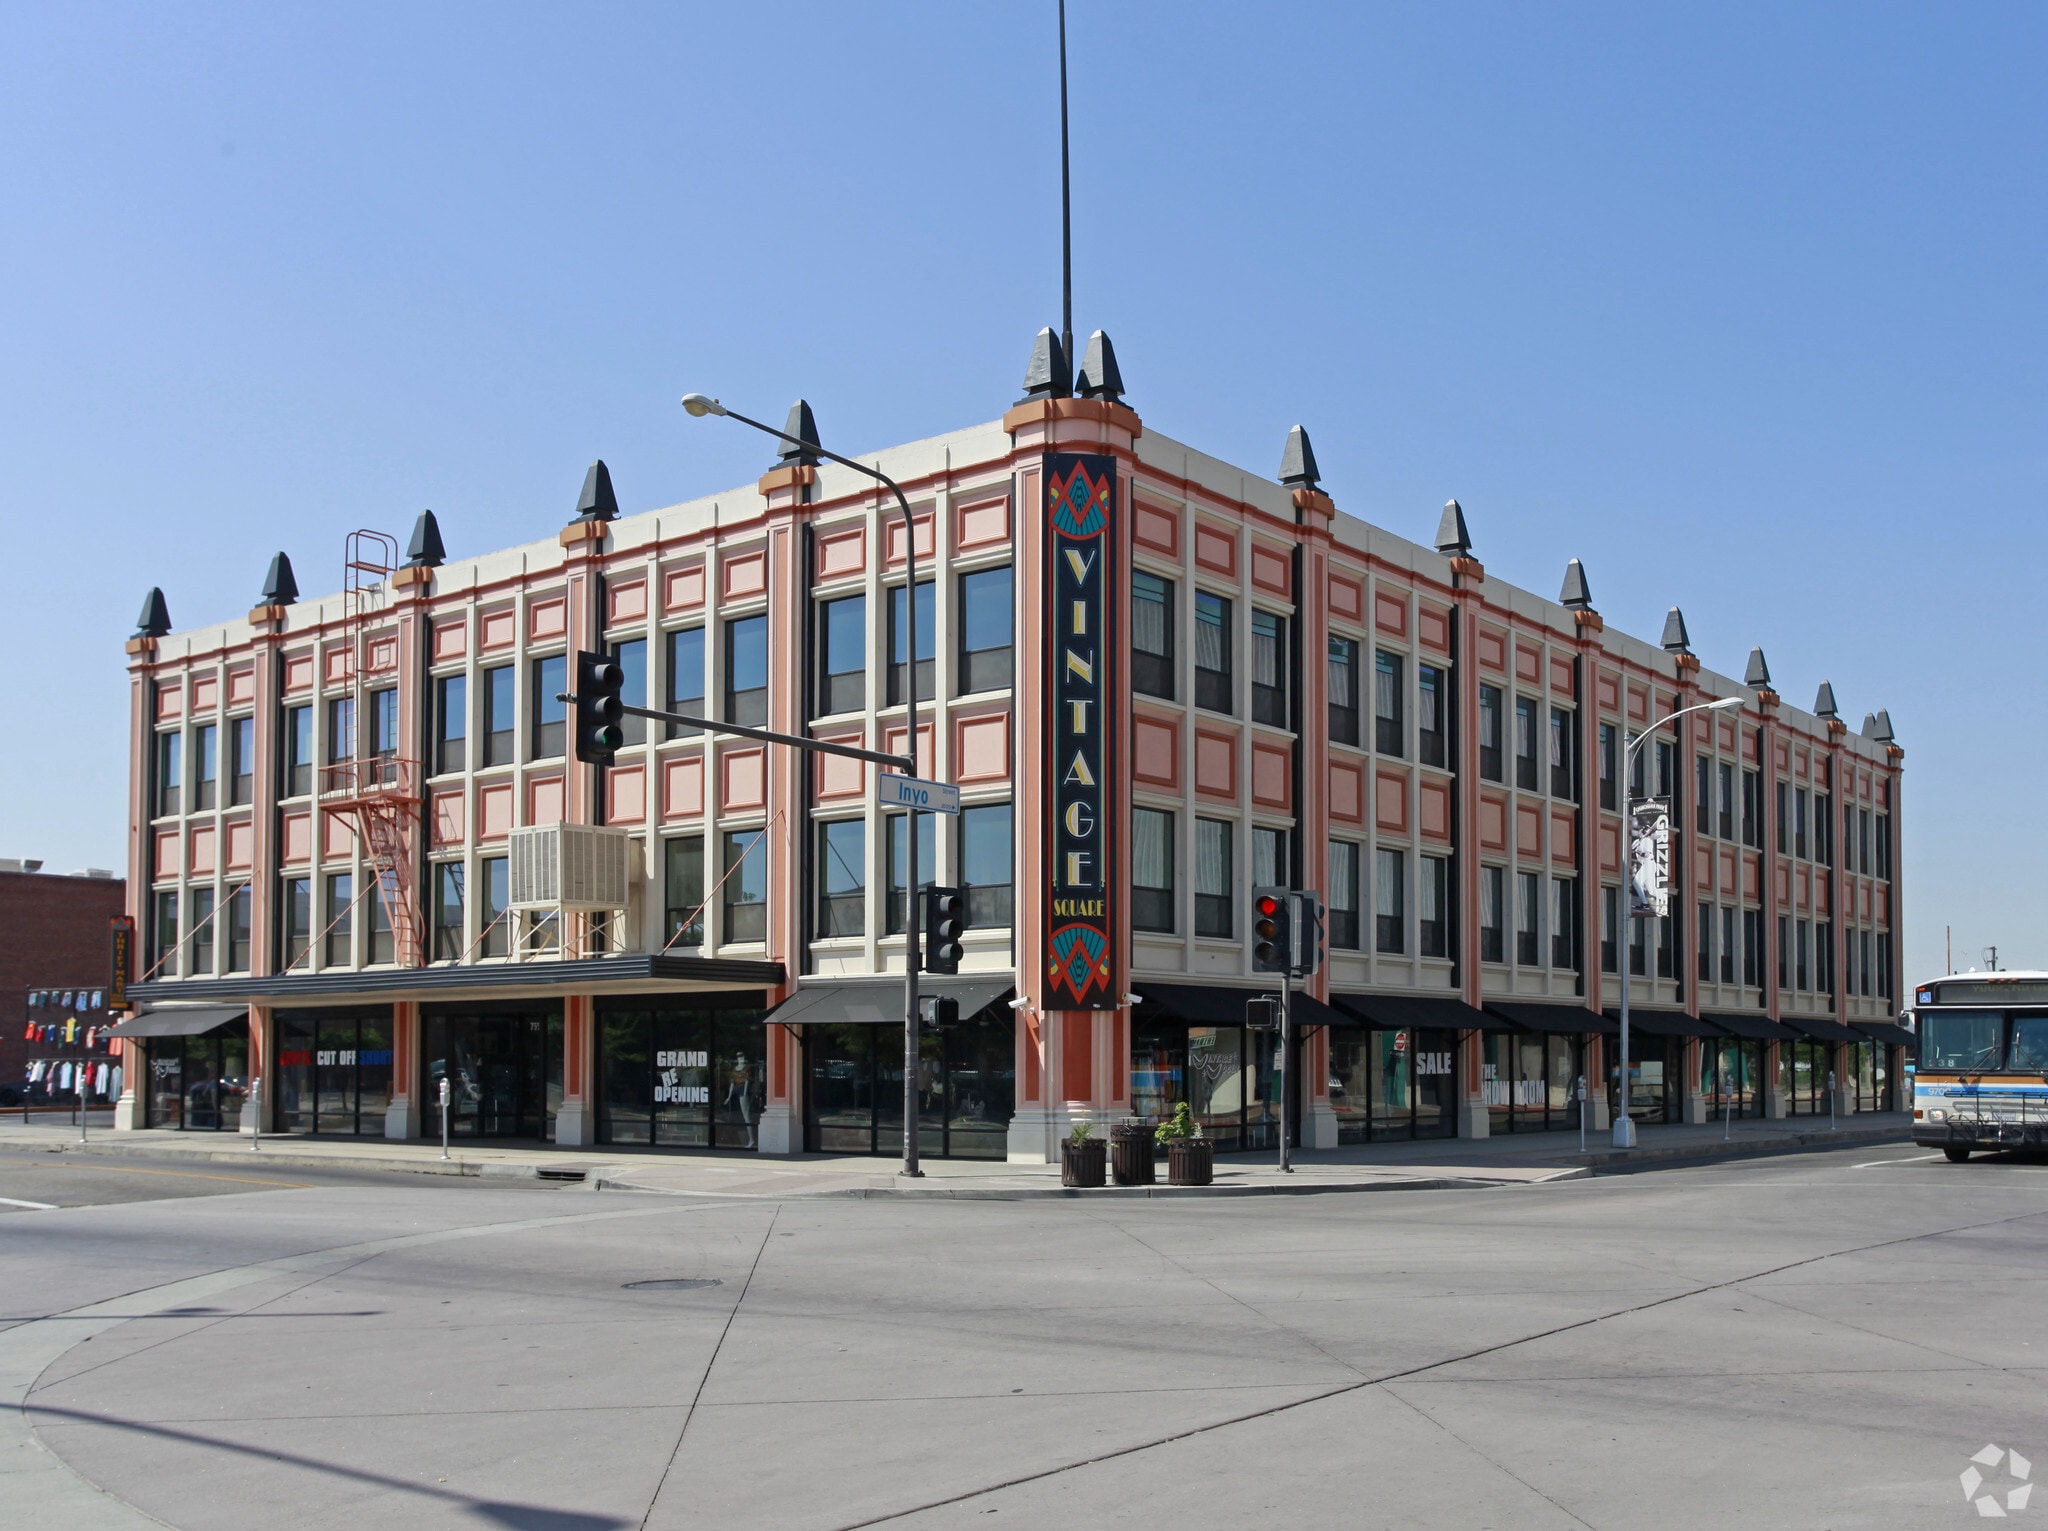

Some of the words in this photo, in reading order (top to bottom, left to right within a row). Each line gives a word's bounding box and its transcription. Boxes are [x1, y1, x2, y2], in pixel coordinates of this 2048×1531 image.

[1063, 549, 1096, 886] VINTAGE
[898, 782, 929, 805] Inyo
[1656, 814, 1669, 918] GRIZZLIES
[1053, 899, 1105, 917] SQUARE
[317, 1050, 336, 1066] CUT
[339, 1050, 356, 1066] OFF
[657, 1051, 708, 1067] GRAND
[1416, 1052, 1452, 1075] SALE
[661, 1067, 678, 1087] RE
[654, 1086, 709, 1103] OPENING
[1481, 1080, 1510, 1105] HOW
